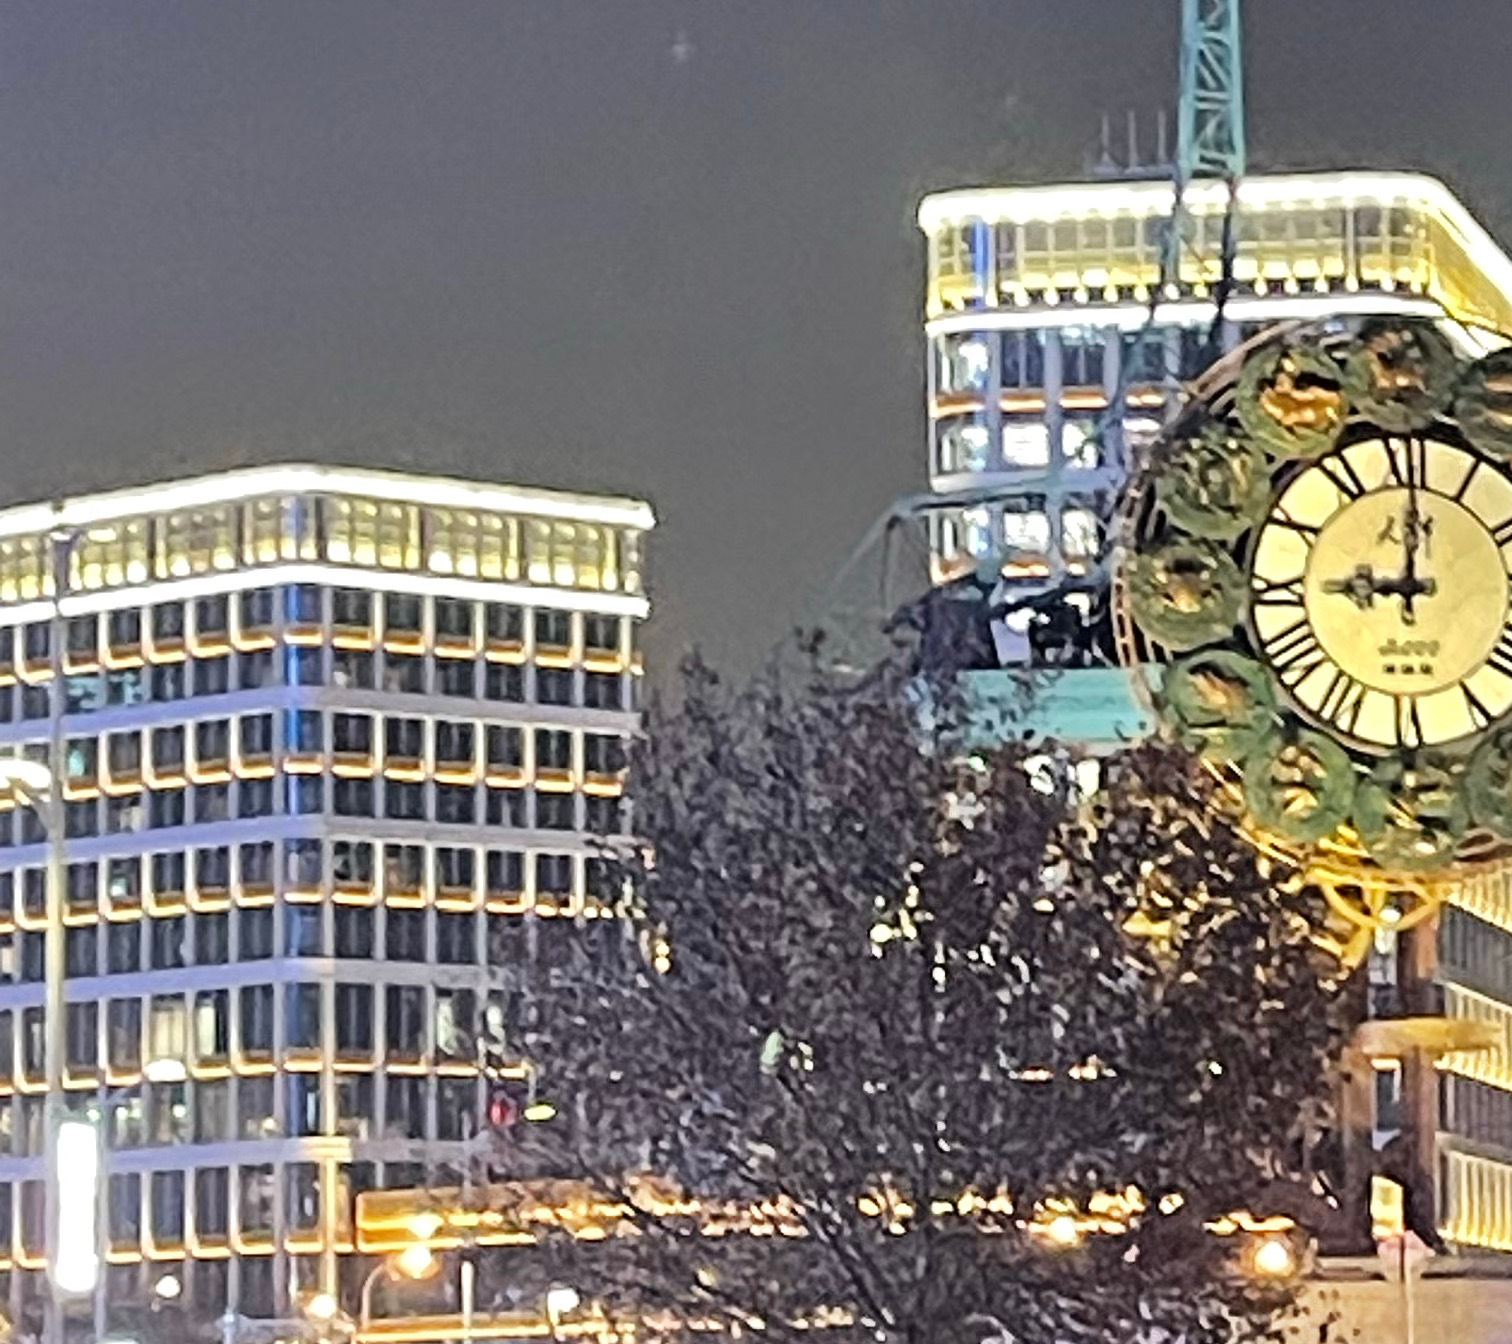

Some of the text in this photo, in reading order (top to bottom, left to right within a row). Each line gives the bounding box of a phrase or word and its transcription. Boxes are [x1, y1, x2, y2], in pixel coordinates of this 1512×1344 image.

[1268, 506, 1319, 548] X
[1252, 573, 1305, 606] IX
[1459, 680, 1494, 730] V
